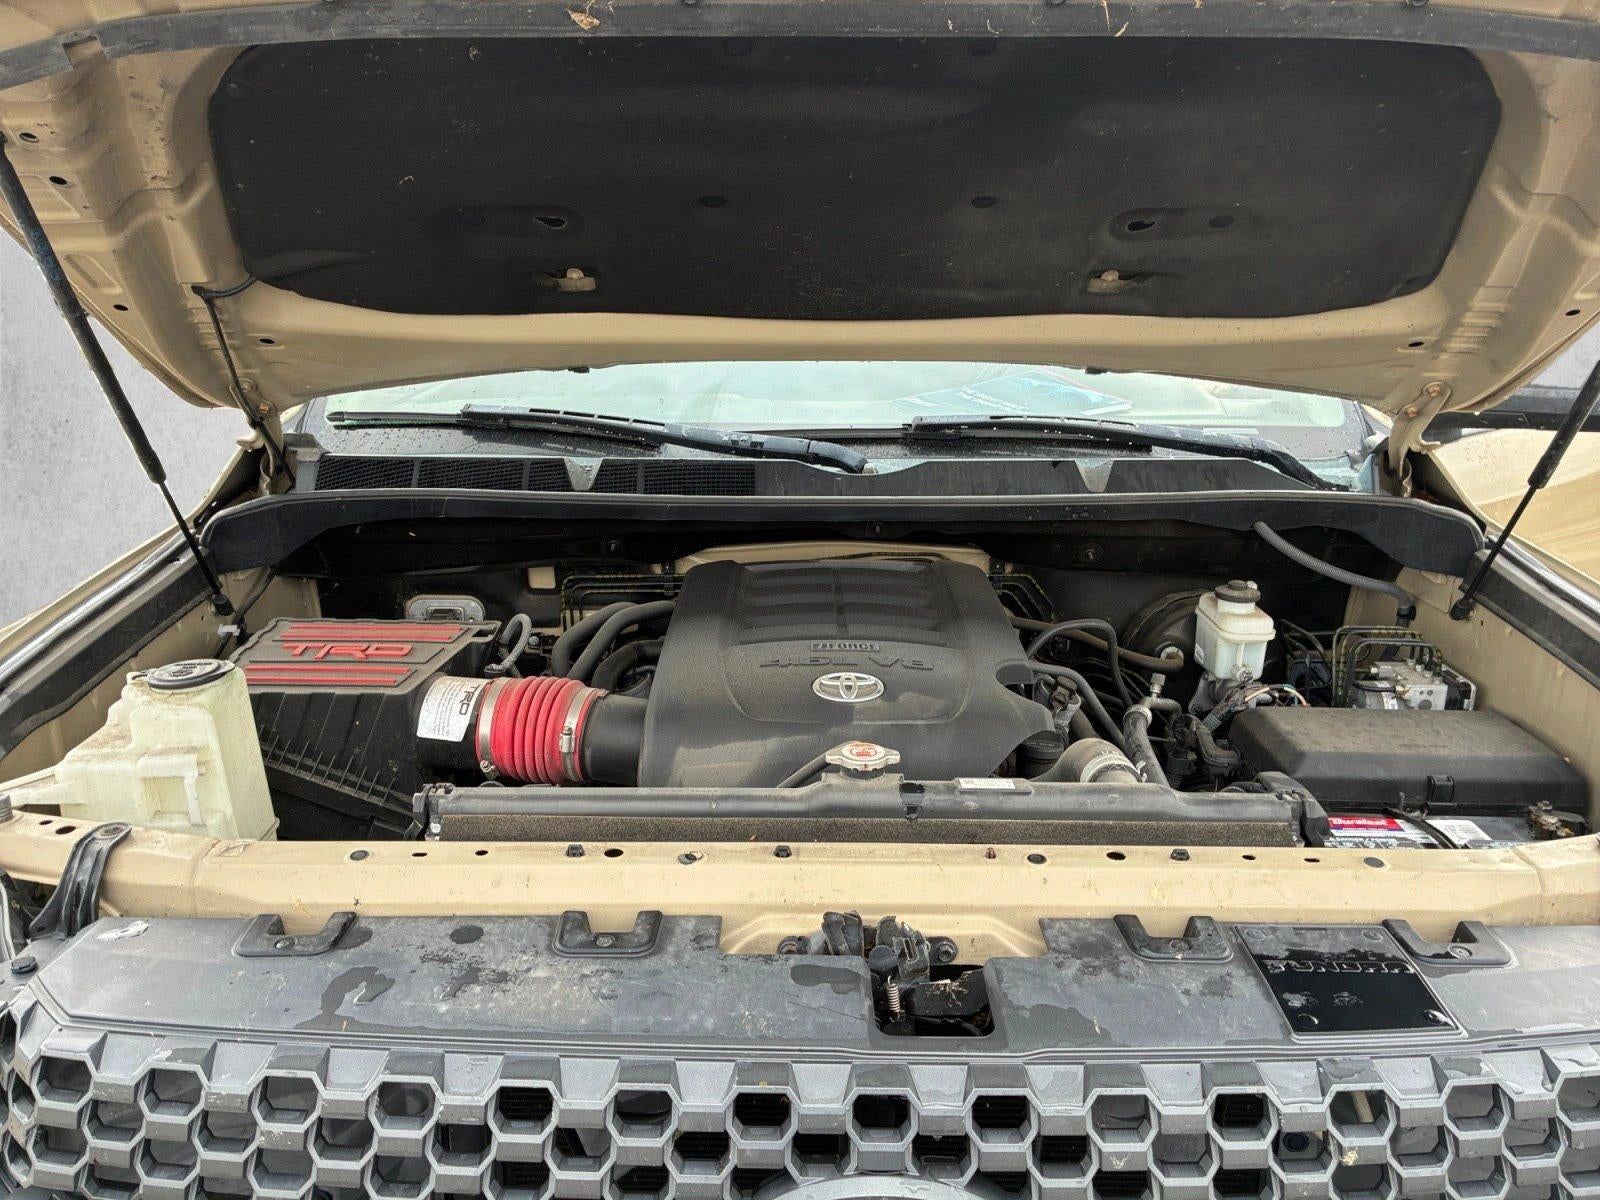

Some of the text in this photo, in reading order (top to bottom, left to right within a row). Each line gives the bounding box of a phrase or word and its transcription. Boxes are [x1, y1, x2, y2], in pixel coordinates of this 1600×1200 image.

[282, 642, 413, 660] TRD
[867, 656, 934, 671] V8
[459, 684, 481, 716] TRD
[1262, 959, 1415, 974] TUNDRA
